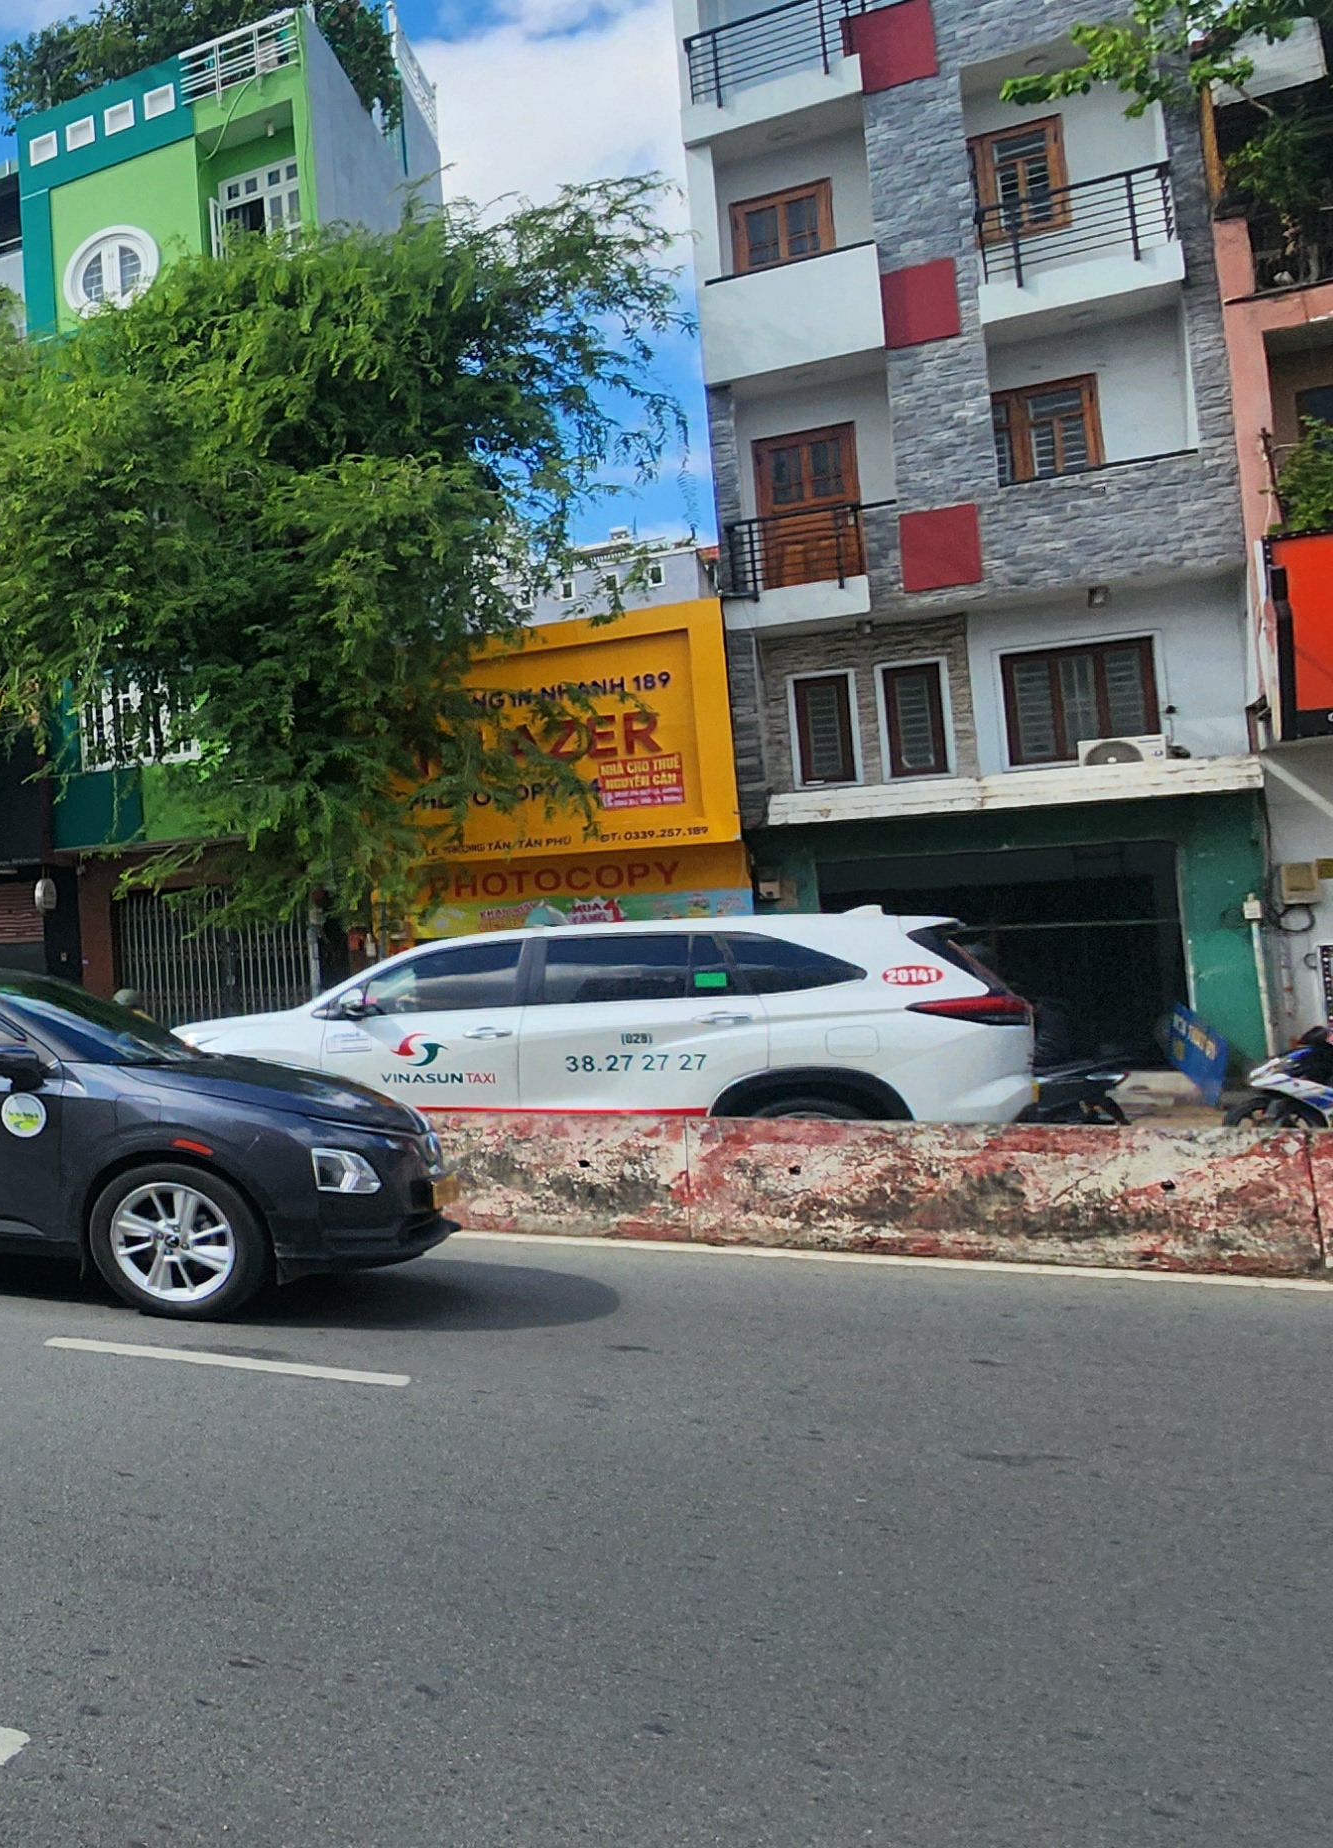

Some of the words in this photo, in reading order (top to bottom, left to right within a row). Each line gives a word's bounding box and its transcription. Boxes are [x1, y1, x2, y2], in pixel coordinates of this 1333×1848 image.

[632, 671, 671, 692] 189
[626, 760, 650, 774] CHO
[430, 860, 680, 898] PHOTOCOPY
[886, 968, 937, 983] 20141
[621, 1033, 653, 1046] (028)
[565, 1054, 634, 1072] 38.27
[641, 1053, 670, 1071] 27
[678, 1053, 708, 1071] 27
[380, 1073, 464, 1084] VINASUN
[465, 1072, 496, 1084] TAXI
